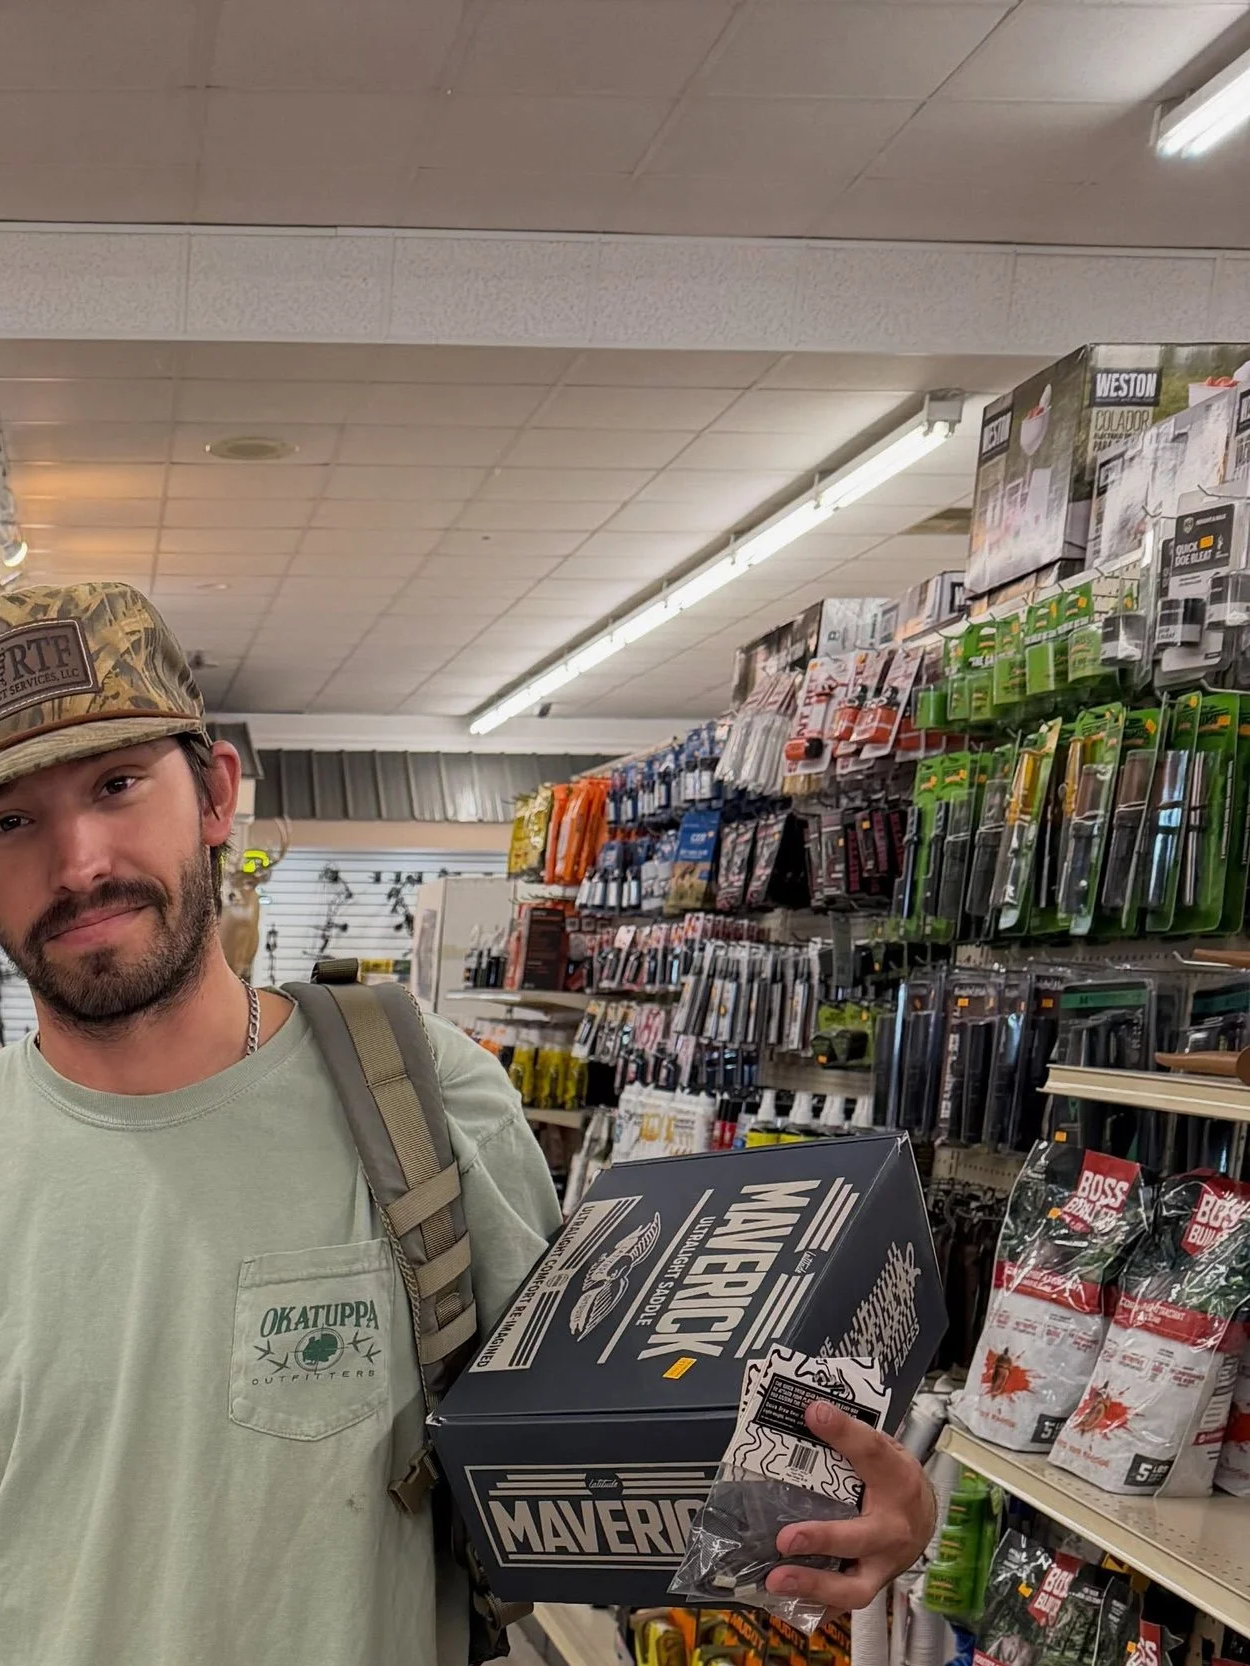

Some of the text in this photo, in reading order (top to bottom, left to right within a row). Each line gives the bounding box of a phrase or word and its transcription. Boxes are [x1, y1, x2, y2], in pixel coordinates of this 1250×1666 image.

[1096, 372, 1157, 398] WESTON
[1176, 541, 1198, 554] QUICK
[1175, 554, 1190, 566] DOE
[3, 634, 71, 682] RTF
[61, 668, 80, 680] LLC
[1077, 1171, 1129, 1208] BOSS
[636, 1215, 716, 1327] ULTRALIGHT SADDLE
[637, 1179, 822, 1362] MAVERICK
[476, 1205, 595, 1368] ULTRALIGHT COMFORT RE-IMAGINED
[260, 1300, 379, 1338] OKATUPPA
[251, 1370, 375, 1386] OUTFITTERS
[1041, 1420, 1053, 1439] 5
[1136, 1463, 1152, 1481] 5
[589, 1479, 618, 1489] Latitude
